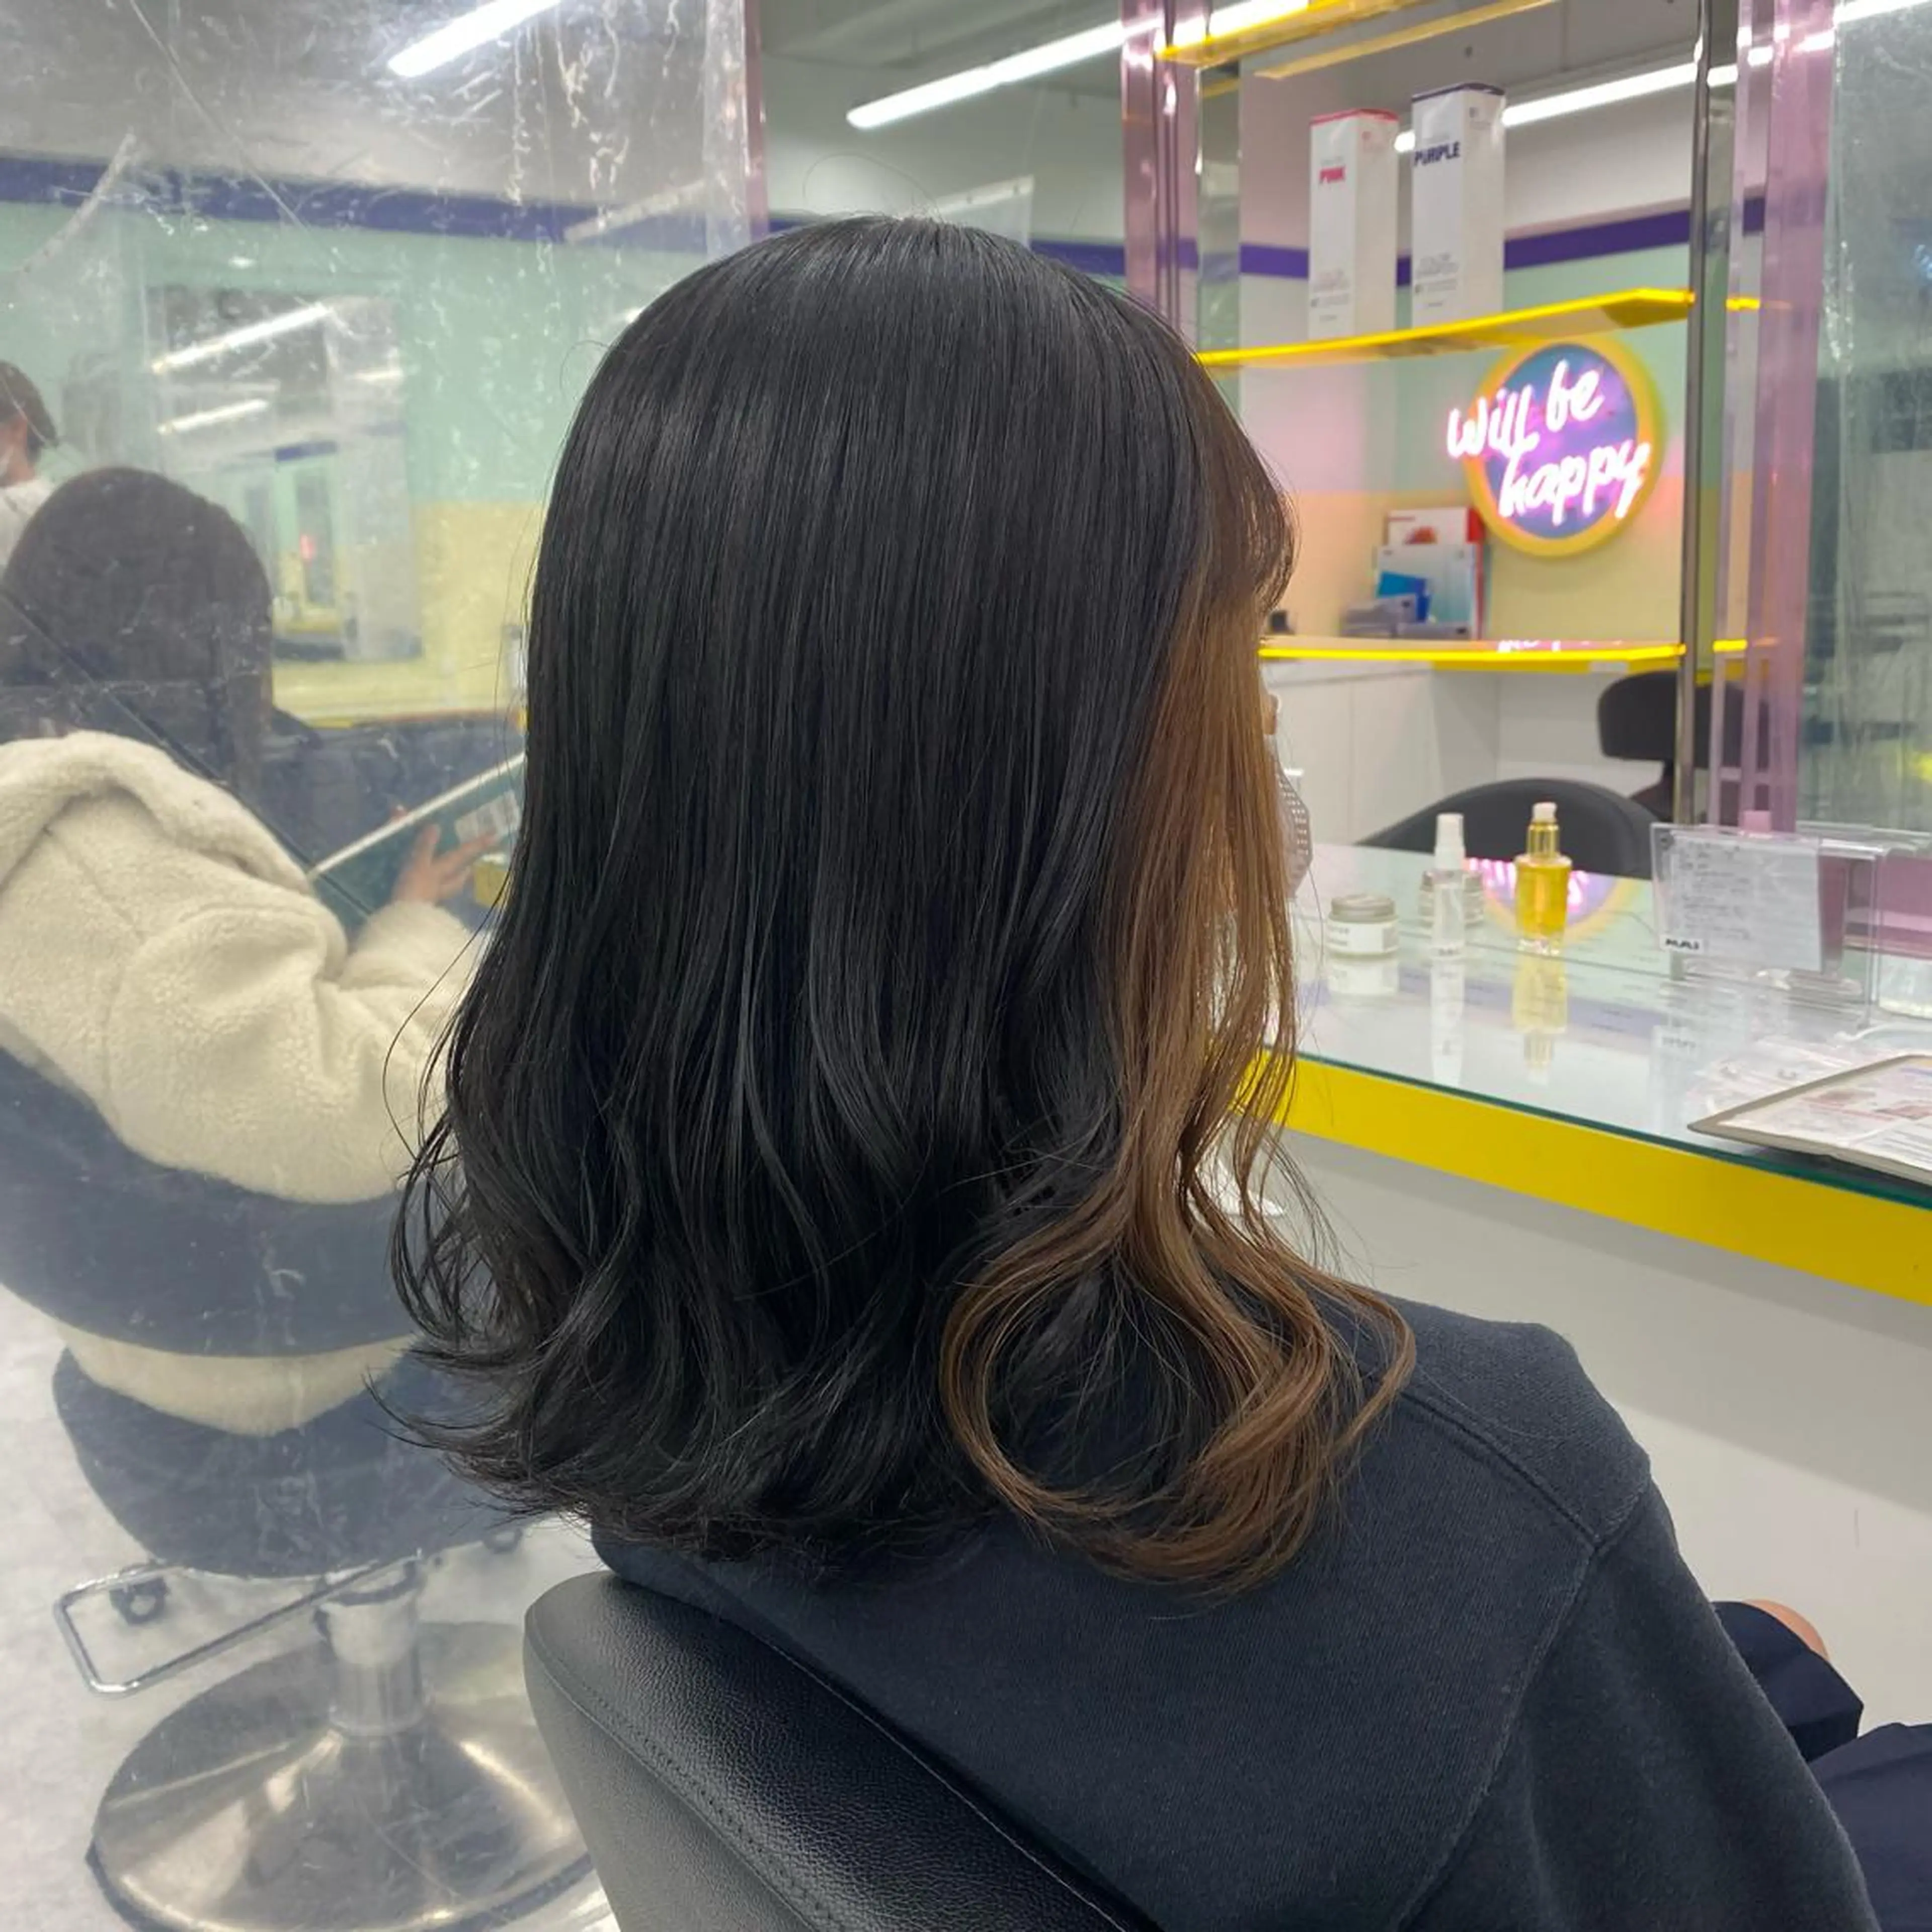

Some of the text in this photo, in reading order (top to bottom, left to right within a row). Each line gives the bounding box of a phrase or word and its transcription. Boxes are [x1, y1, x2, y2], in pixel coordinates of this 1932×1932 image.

[1414, 141, 1461, 167] PURPLE
[1446, 359, 1605, 458] will be
[1498, 440, 1651, 526] happy
